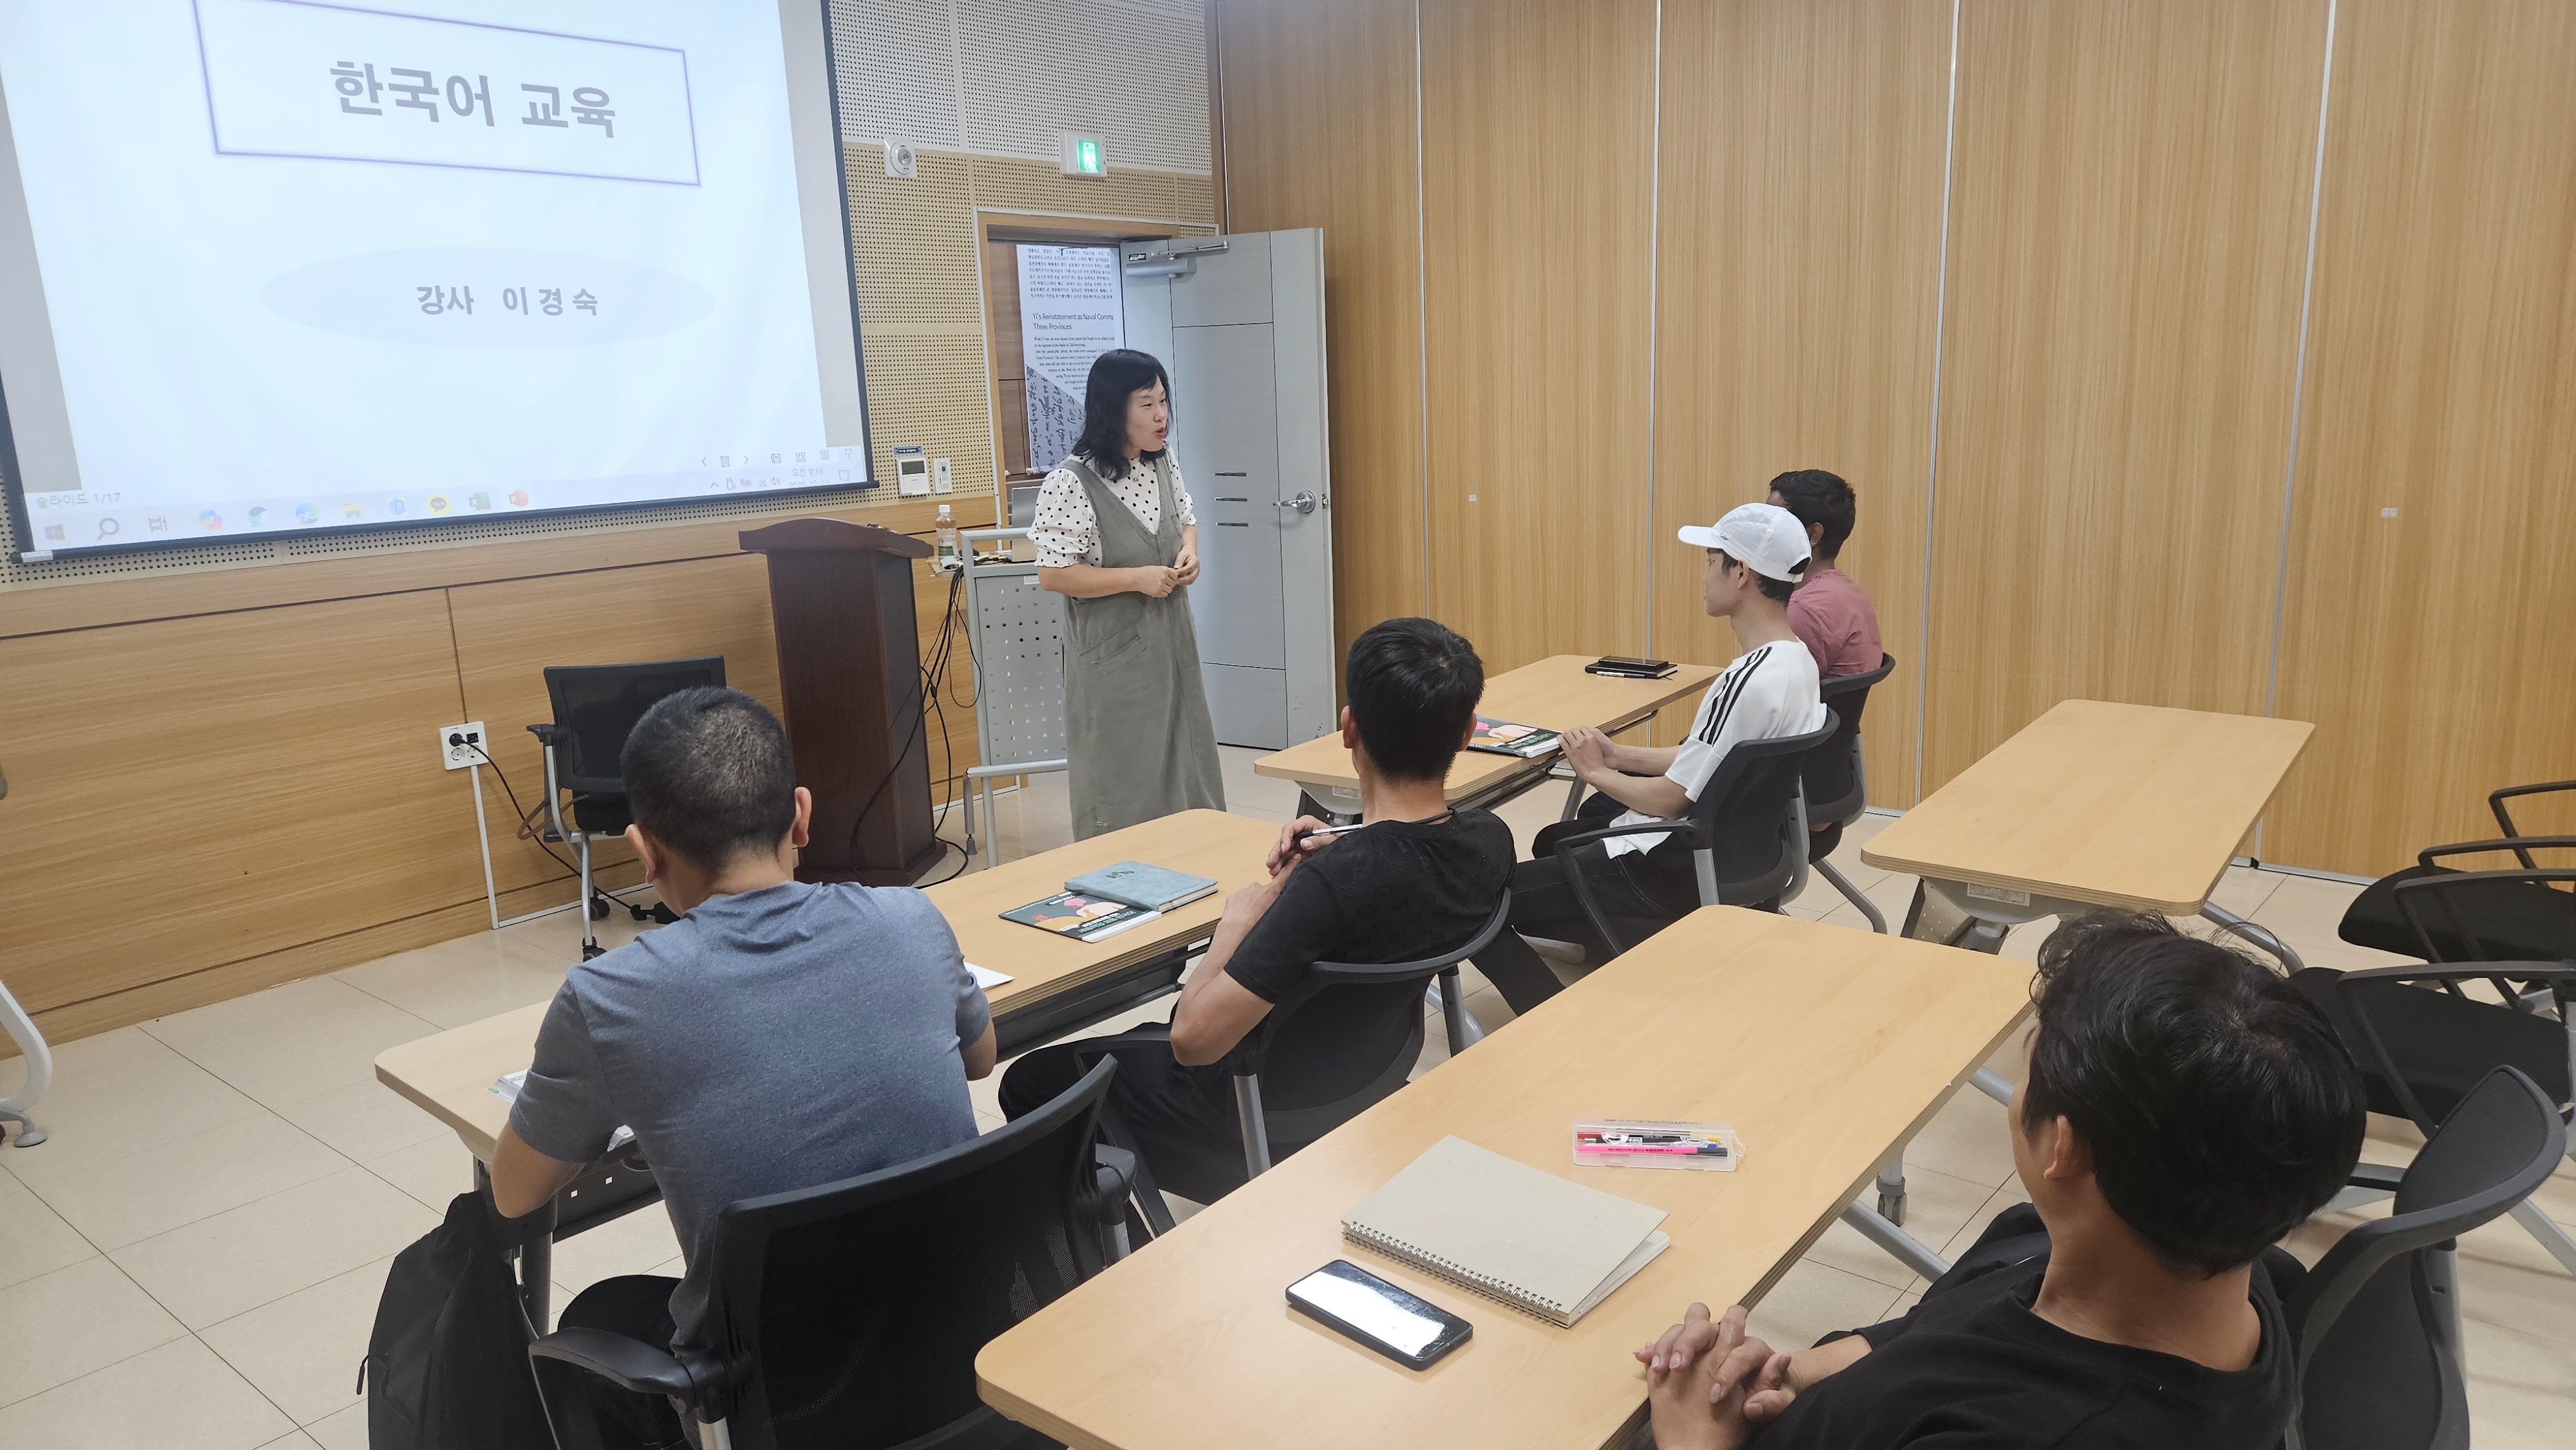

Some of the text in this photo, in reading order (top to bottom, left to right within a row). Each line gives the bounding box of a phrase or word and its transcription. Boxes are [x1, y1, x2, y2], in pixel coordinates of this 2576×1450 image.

[330, 61, 616, 138] 한국어 교육
[417, 285, 475, 315] 강사
[791, 467, 824, 476] 오전 9:16
[36, 493, 120, 509] 슬라이드 1/17
